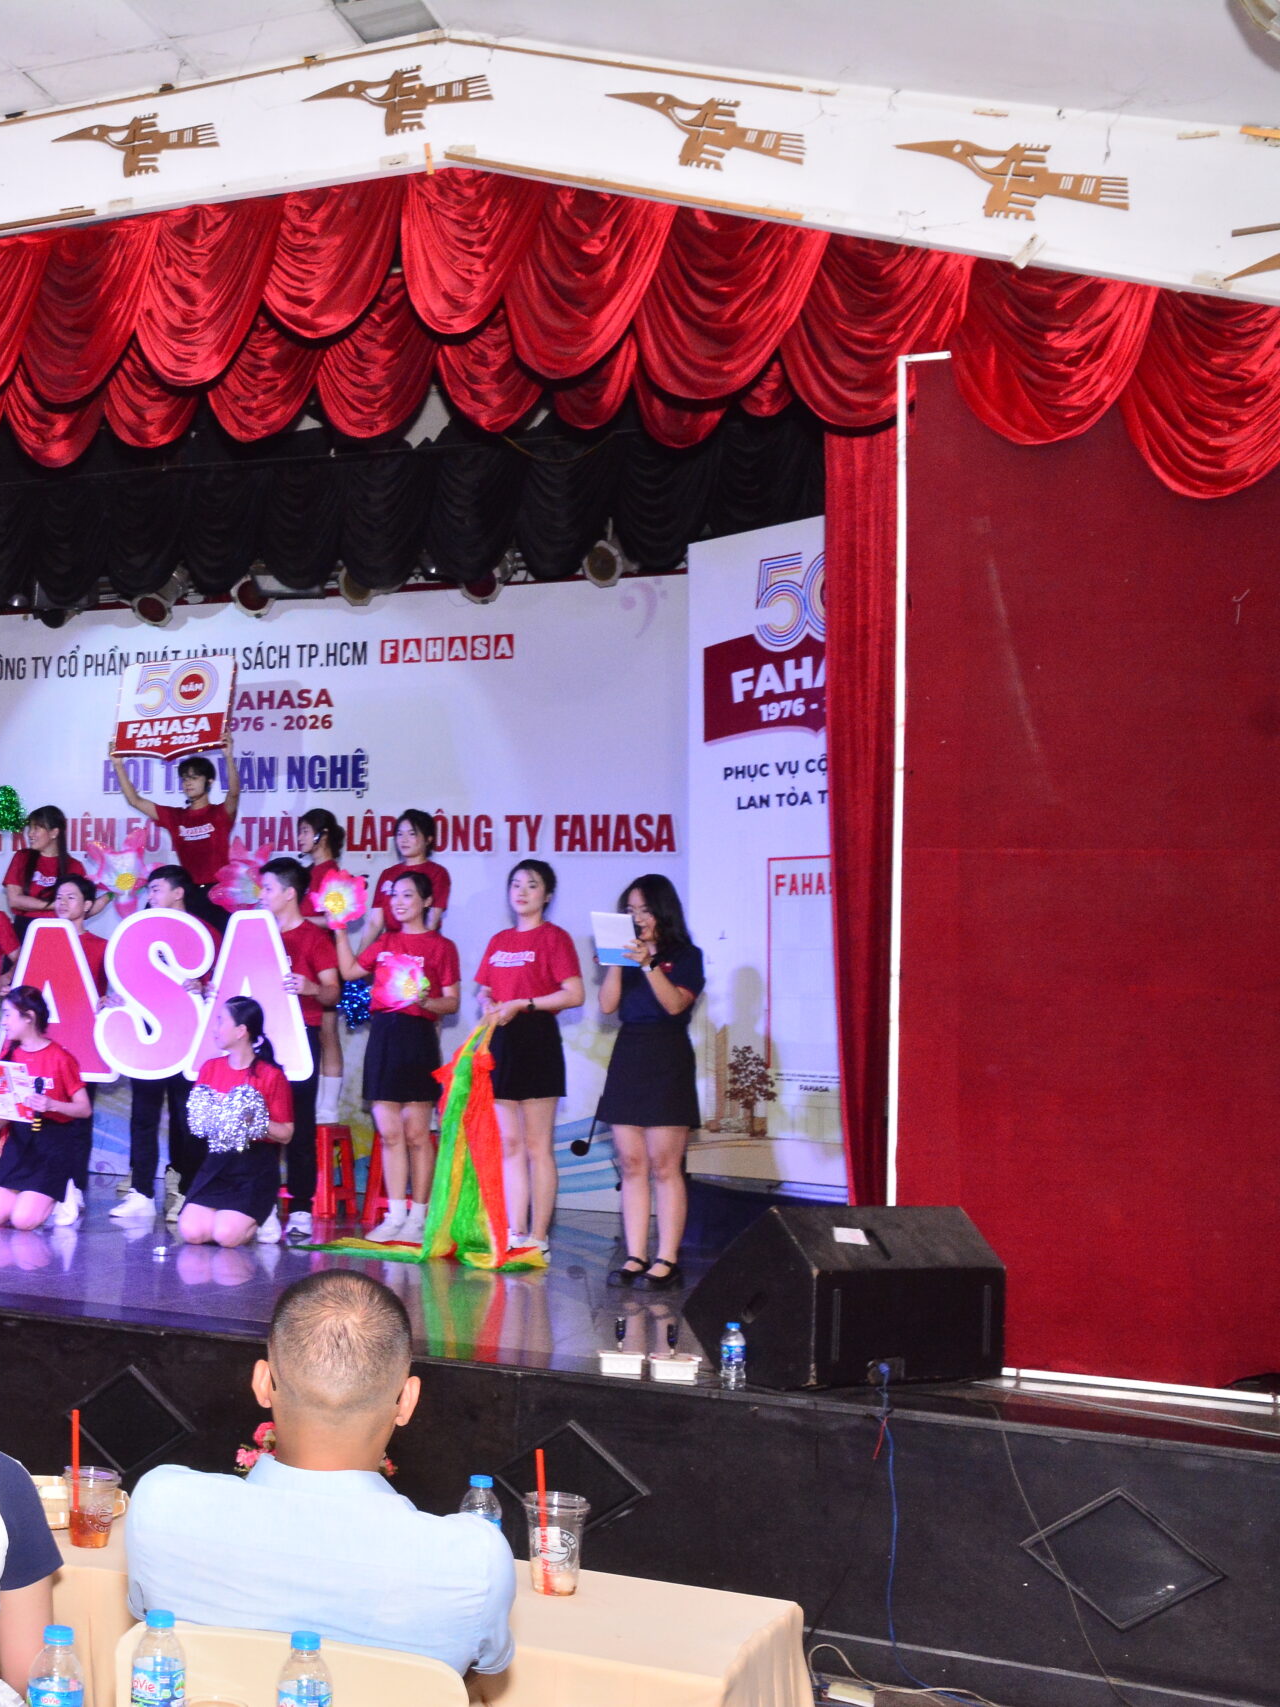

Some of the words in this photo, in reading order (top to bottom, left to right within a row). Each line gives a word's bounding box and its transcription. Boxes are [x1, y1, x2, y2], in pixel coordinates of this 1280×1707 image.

[32, 656, 53, 679] TY
[57, 645, 81, 678] CỔ
[84, 645, 129, 677] PHẦN
[242, 641, 290, 670] SÁCH
[296, 641, 368, 668] TP.HCM
[380, 634, 514, 664] FAHASA
[135, 660, 219, 717] 50
[180, 682, 205, 693] NĂM
[731, 656, 826, 704] FAH
[235, 688, 334, 711] AHASA
[759, 698, 805, 722] 1976
[126, 717, 211, 739] FAHASA
[229, 716, 265, 733] 976
[283, 714, 333, 731] 2026
[136, 737, 162, 748] 1976
[170, 734, 200, 746] 2026
[217, 751, 278, 792] VĂN
[287, 749, 368, 798] NGHỆ
[723, 763, 770, 782] PHỤC
[775, 760, 799, 779] VỤ
[805, 753, 828, 776] CỘ
[737, 794, 770, 810] LAN
[70, 811, 116, 858] IỆM
[241, 810, 303, 852] THÀ
[346, 809, 397, 859] LẬP
[431, 808, 493, 852] ÔNG
[505, 814, 543, 852] TY
[554, 814, 677, 852] FAHASA
[775, 872, 832, 896] FAHA
